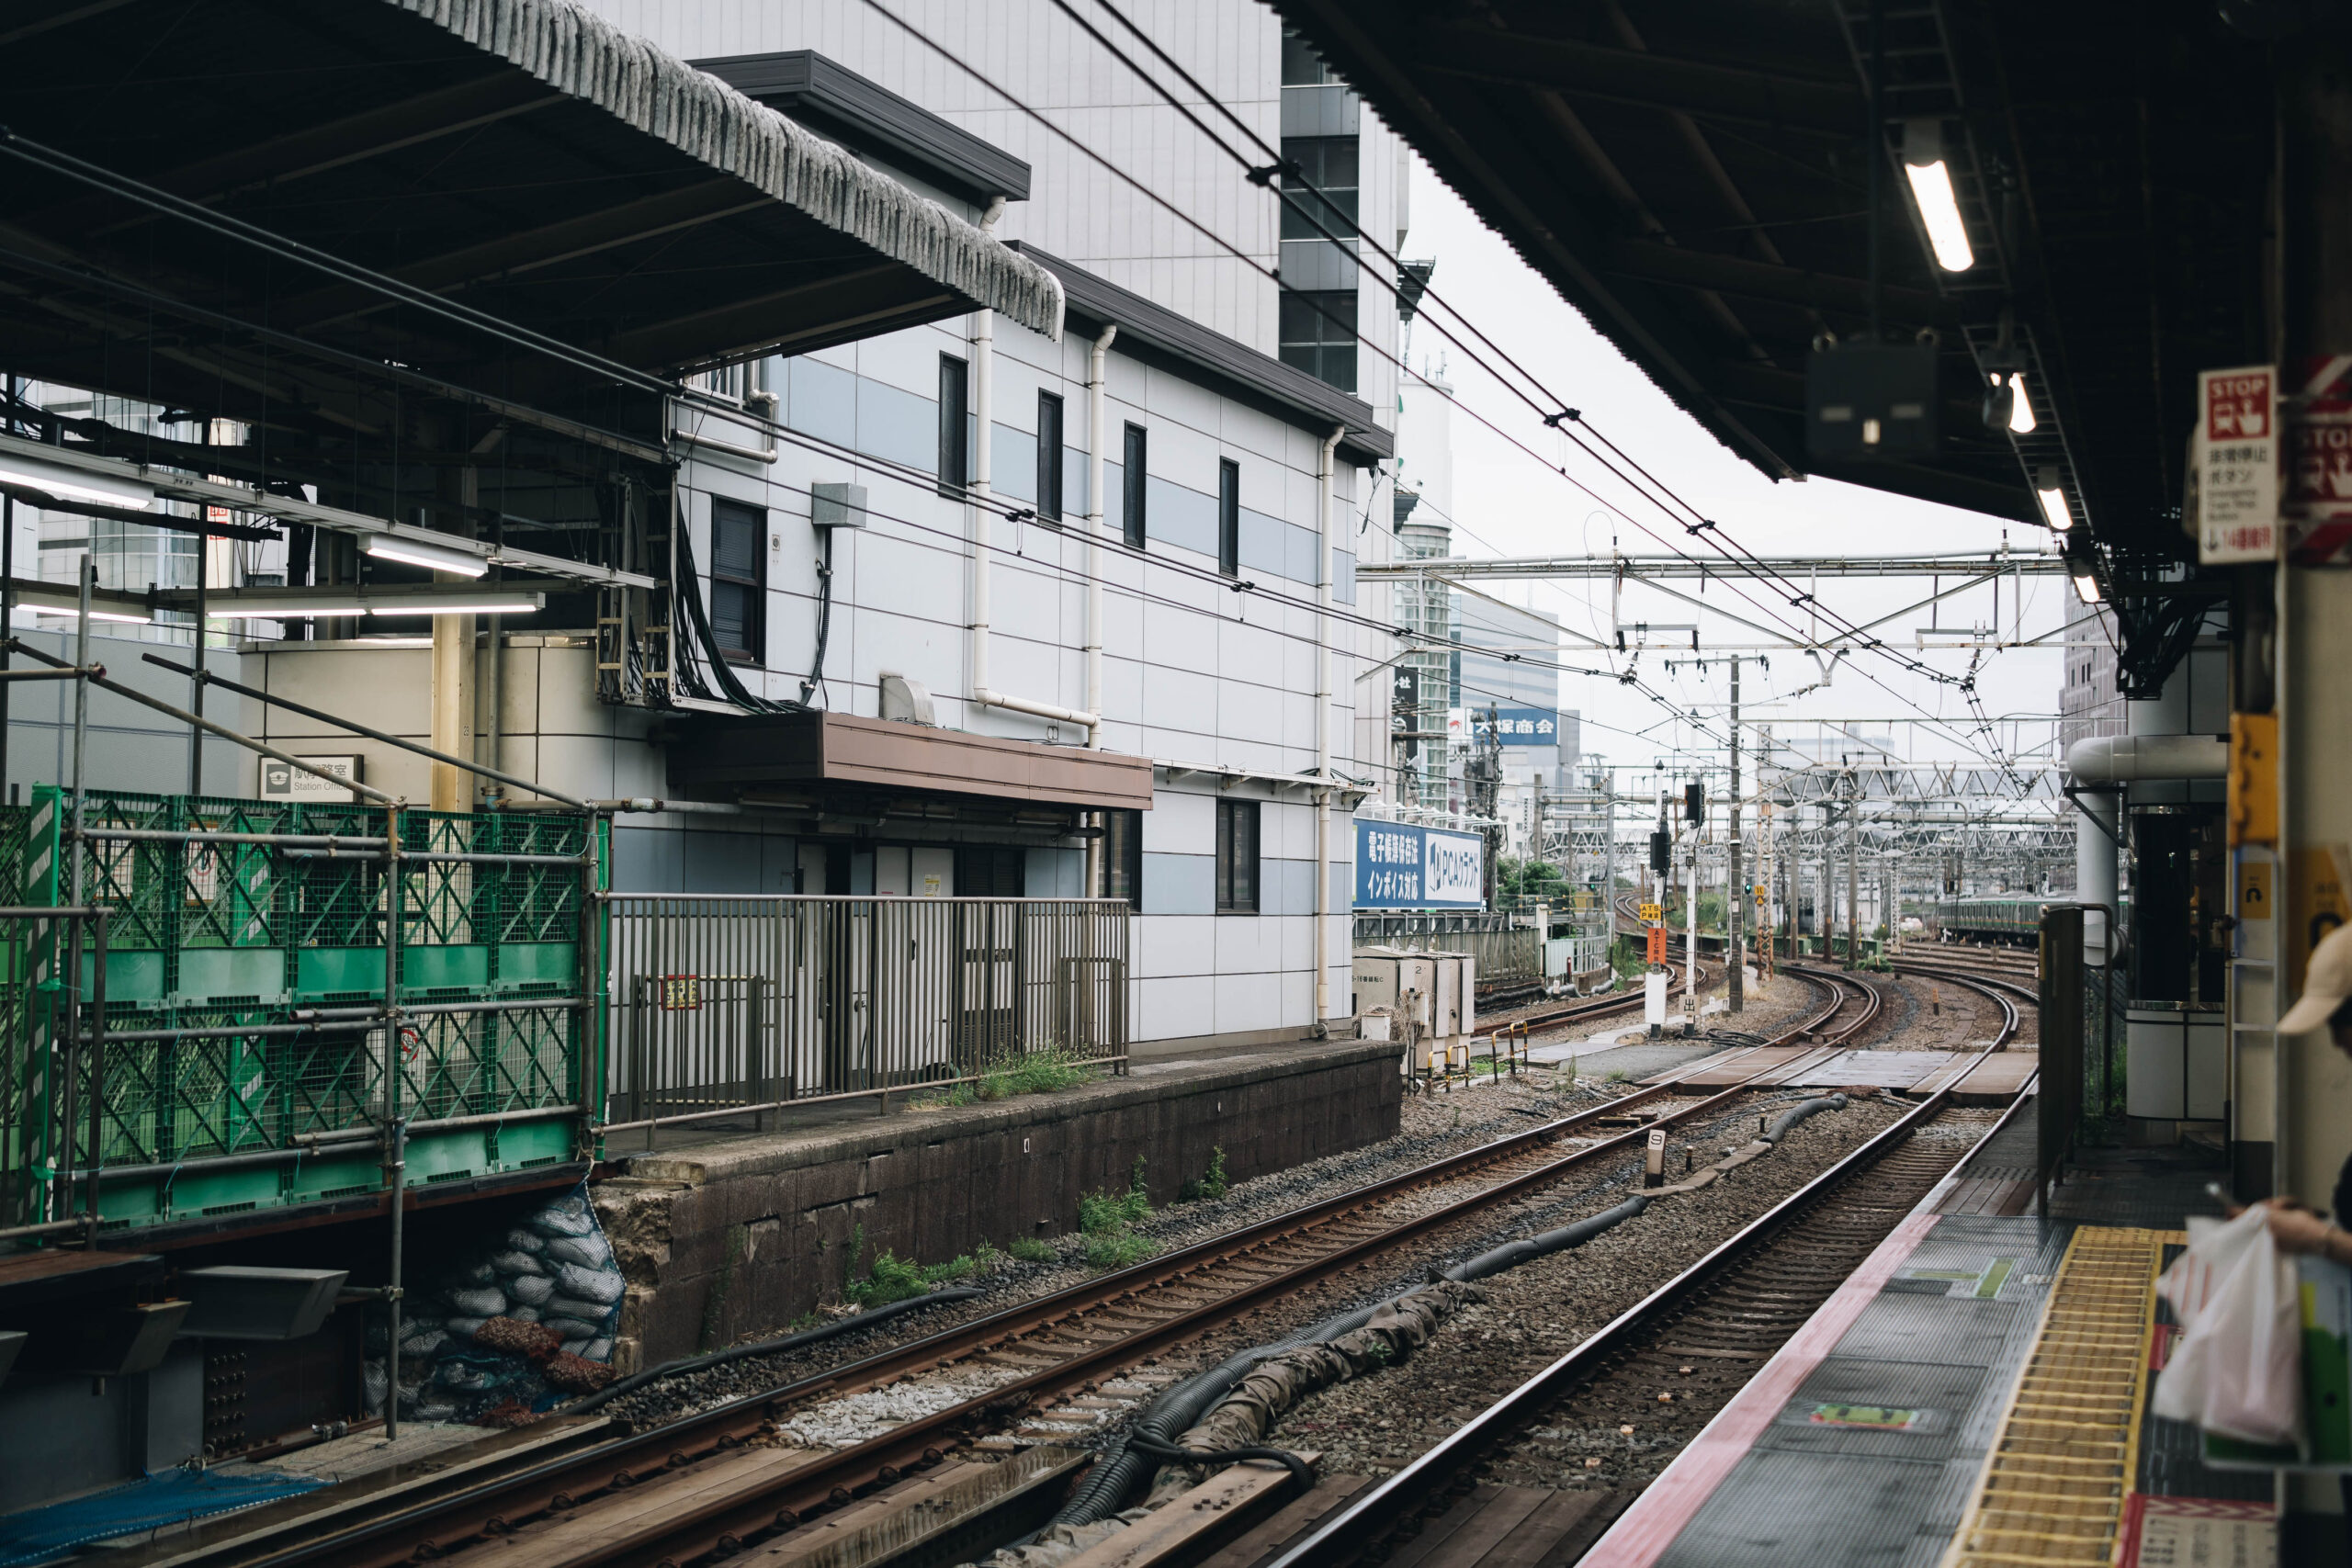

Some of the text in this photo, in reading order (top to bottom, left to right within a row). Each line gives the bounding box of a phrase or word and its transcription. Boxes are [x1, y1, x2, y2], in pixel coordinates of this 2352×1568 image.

[2211, 378, 2266, 398] STOP
[2296, 428, 2352, 448] STO
[2209, 447, 2267, 464] 非常停止
[2209, 468, 2254, 484] ボタン
[1476, 718, 1554, 735] 大塚商会
[294, 763, 346, 780] 駅務室
[294, 782, 322, 791] Station
[1368, 830, 1419, 865] 電子帳簿保存法
[1442, 850, 1478, 889] PCAクラウド
[1368, 869, 1419, 901] インボイス対応
[1415, 965, 1422, 975] 2
[1684, 998, 1695, 1012] 出
[1650, 1134, 1663, 1145] 9
